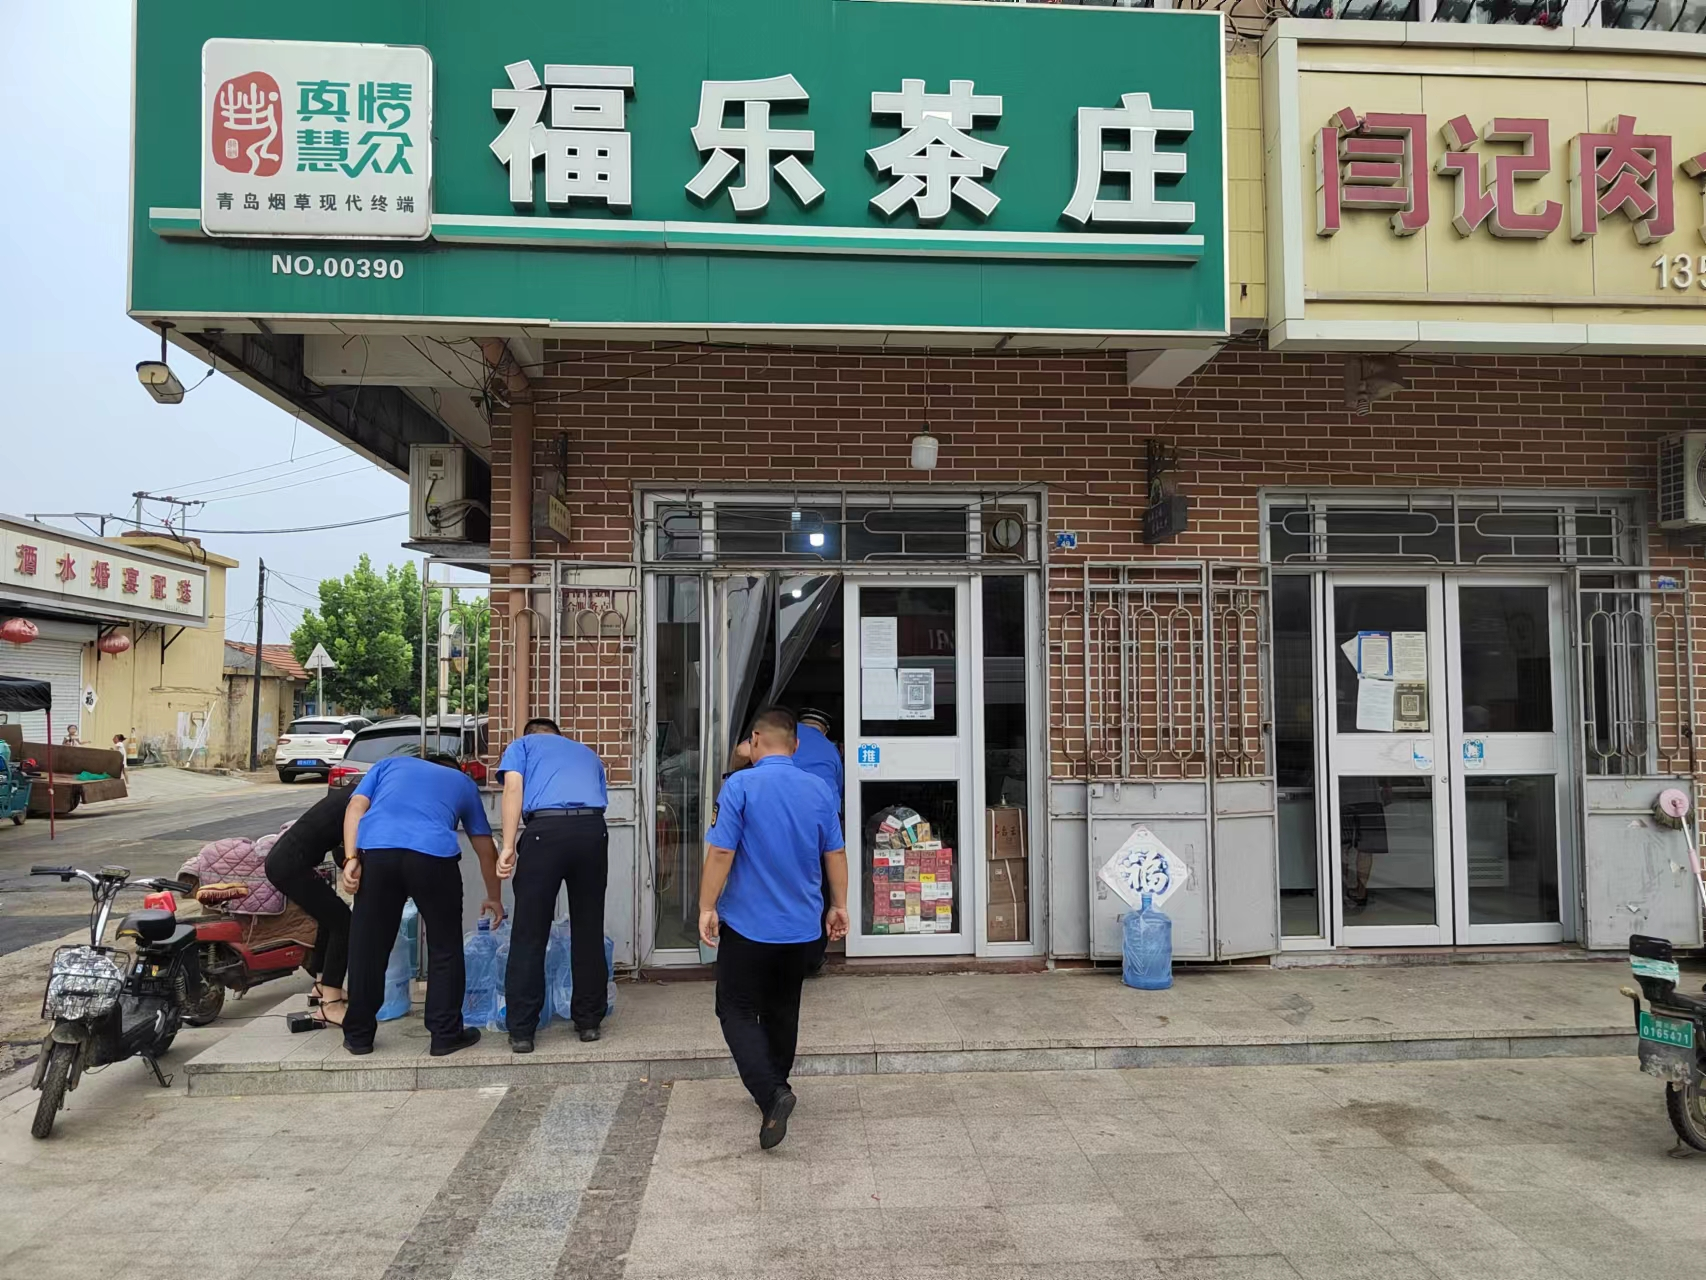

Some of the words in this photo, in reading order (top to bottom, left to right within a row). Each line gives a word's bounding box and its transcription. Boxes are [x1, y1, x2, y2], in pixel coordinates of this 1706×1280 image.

[296, 80, 413, 130] 真情
[296, 130, 414, 179] 慧众
[489, 59, 1197, 227] 福乐茶庄
[1314, 106, 1706, 246] 闫记肉
[215, 191, 415, 214] 青岛烟草现代终端
[271, 254, 405, 280] NO.00390
[14, 544, 192, 604] 酒水婚宴配送
[861, 749, 876, 762] 推
[1643, 1025, 1689, 1045] 0165471
